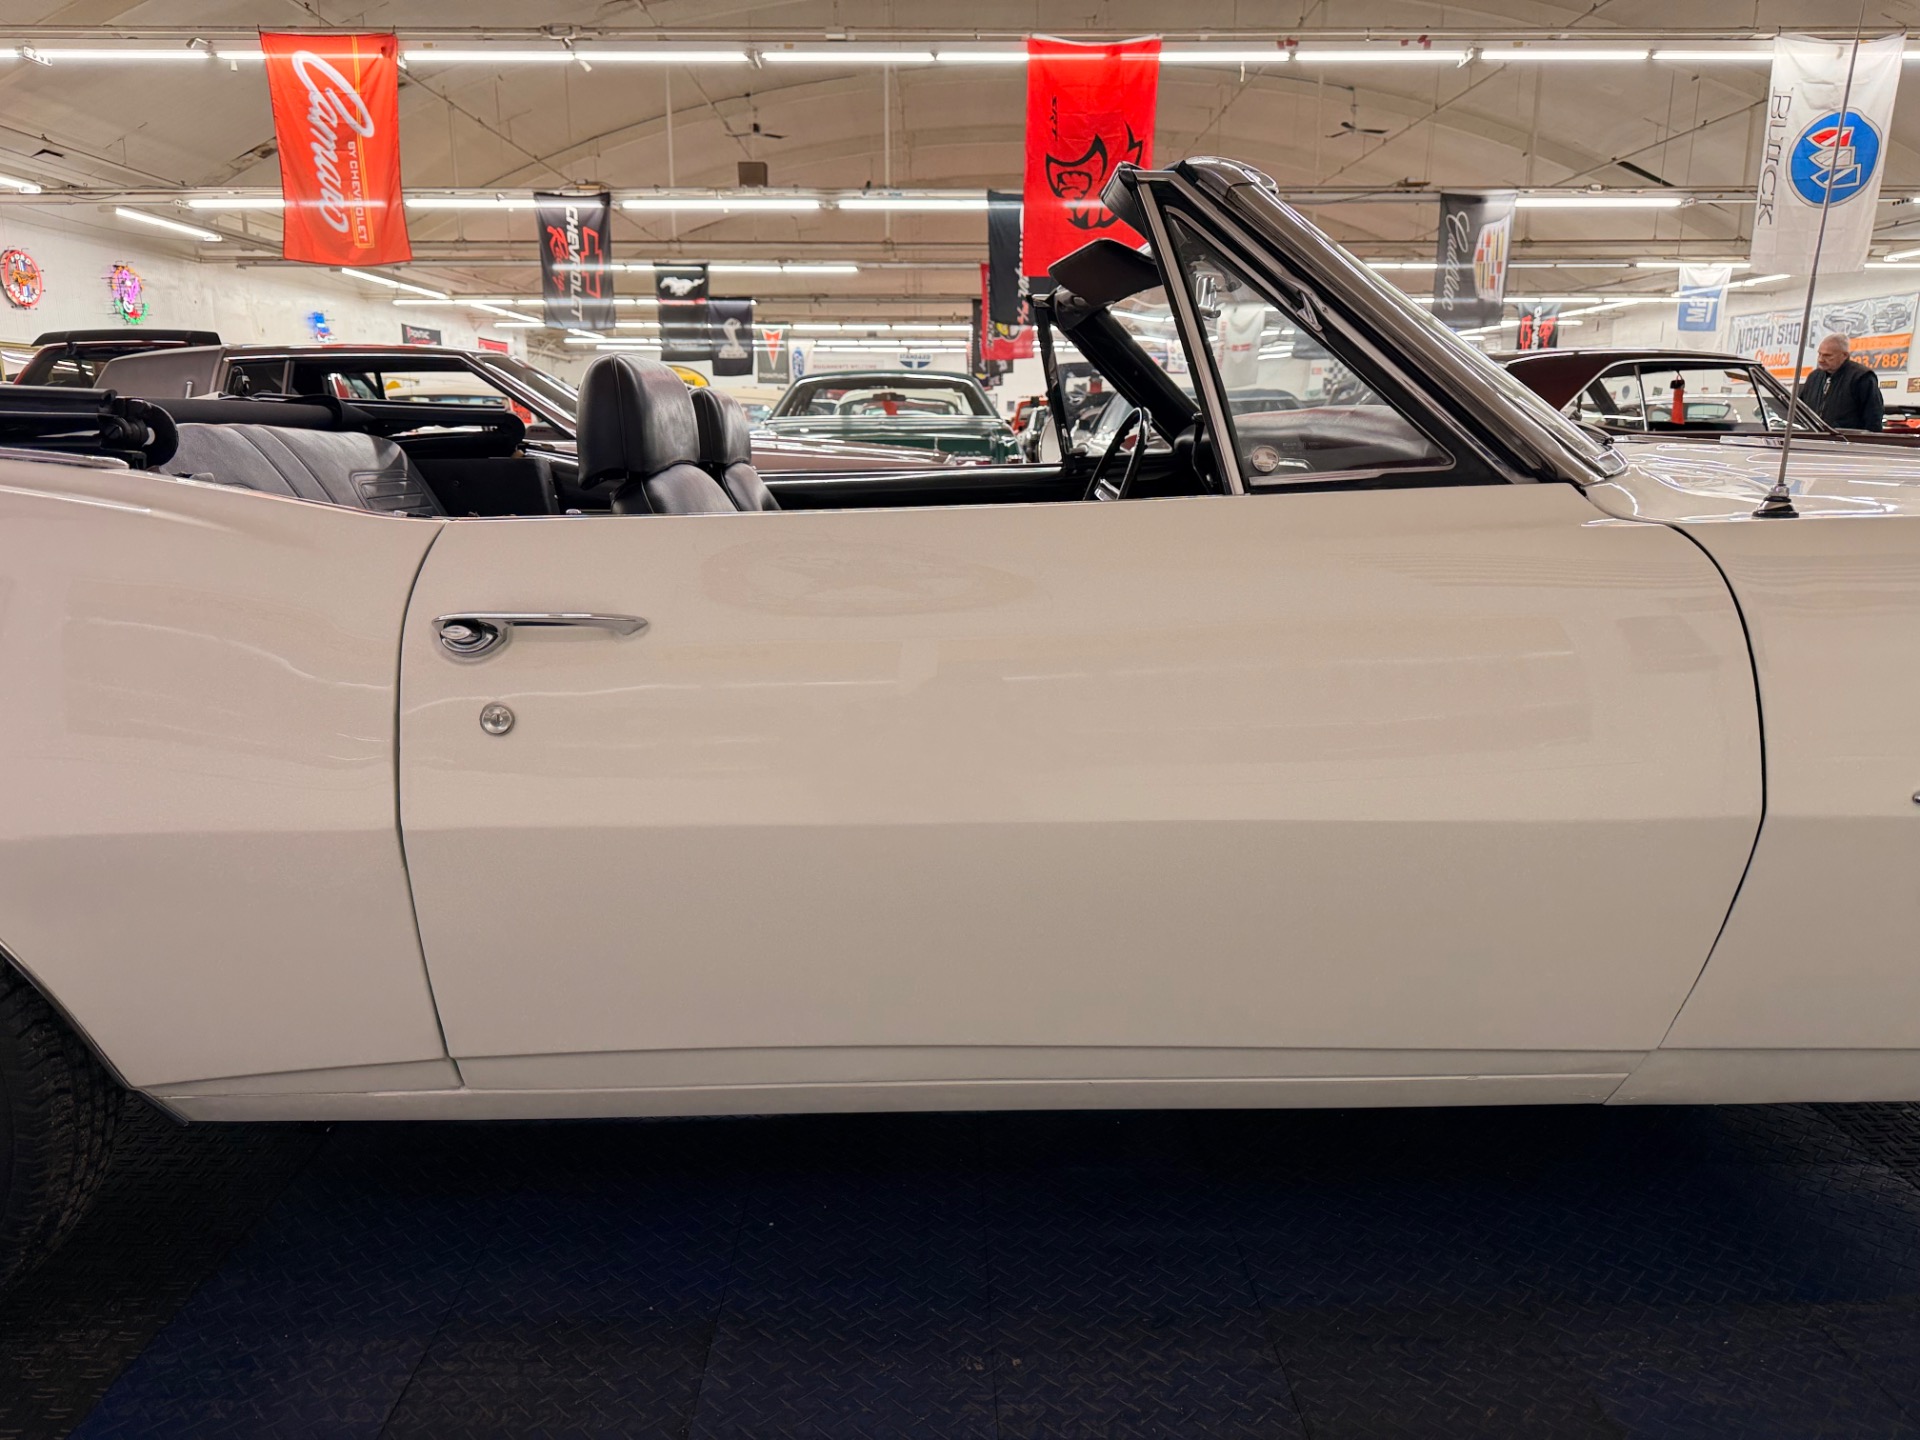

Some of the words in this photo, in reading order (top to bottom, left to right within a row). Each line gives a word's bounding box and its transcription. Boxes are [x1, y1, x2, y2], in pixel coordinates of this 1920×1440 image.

[291, 50, 375, 234] Camaro
[347, 141, 357, 158] BY
[1757, 86, 1795, 226] BUICK
[349, 160, 369, 242] CHEVROLET
[10, 253, 32, 265] FORD
[546, 225, 569, 293] Racng
[565, 205, 583, 322] CHEVROLET
[1441, 211, 1471, 311] Cadillac
[1735, 324, 1775, 355] NORTH
[1776, 319, 1819, 349] SHOE
[1754, 348, 1791, 367] Classics
